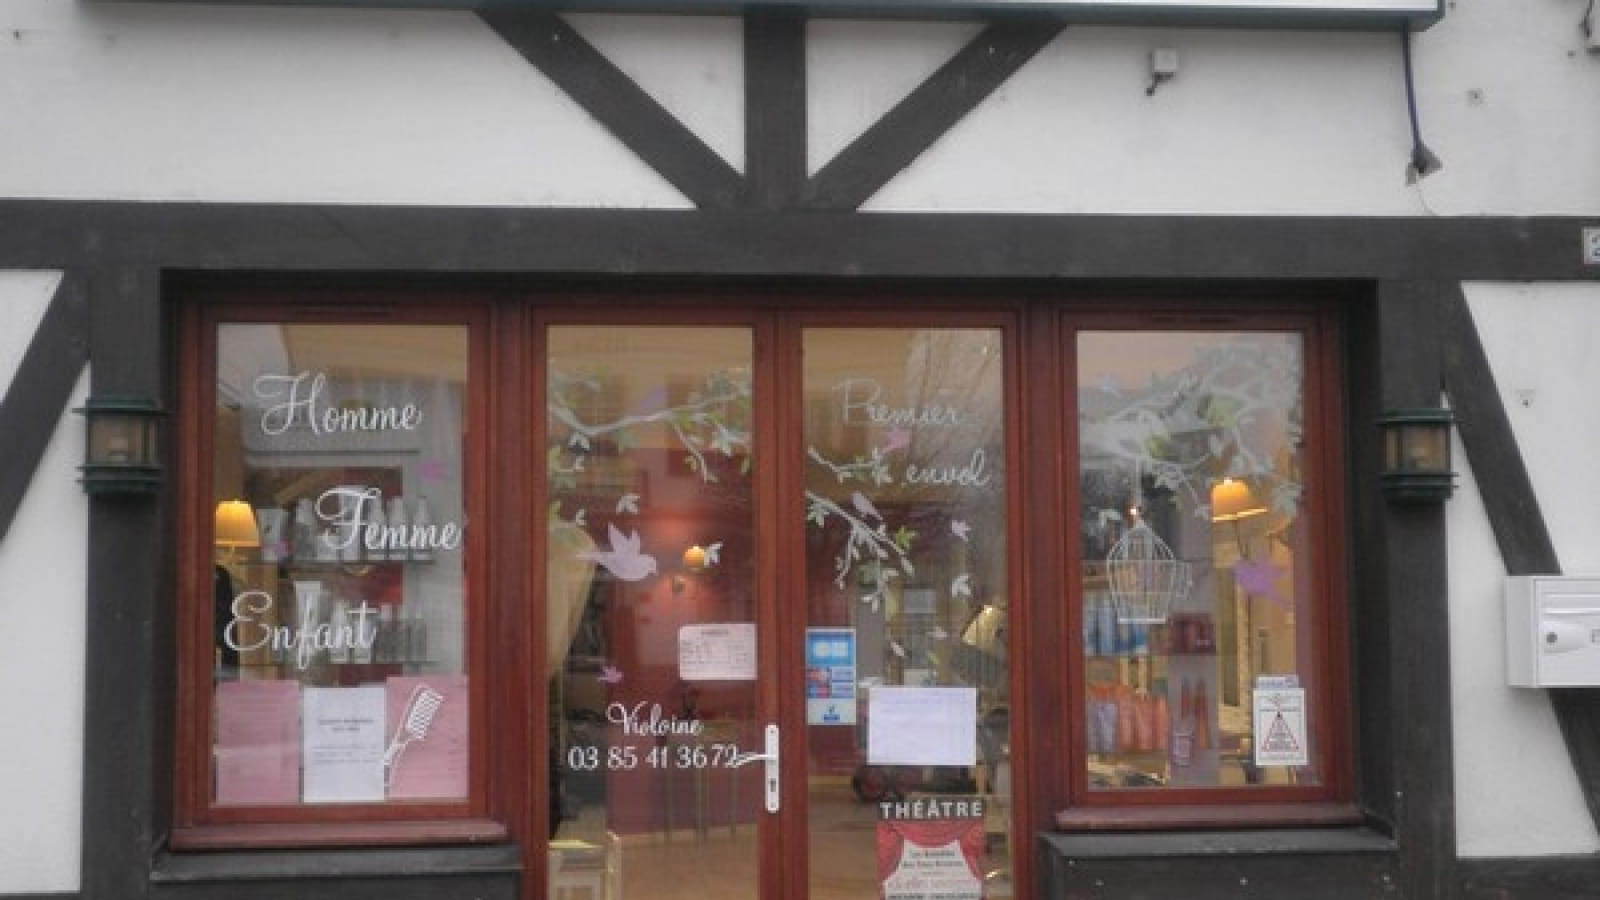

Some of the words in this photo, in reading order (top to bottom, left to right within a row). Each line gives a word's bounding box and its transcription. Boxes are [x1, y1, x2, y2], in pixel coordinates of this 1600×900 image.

[253, 369, 423, 436] Homme
[832, 374, 963, 425] Premier
[901, 447, 992, 487] envol
[313, 485, 462, 550] Femme
[222, 590, 379, 671] Enfant
[605, 700, 704, 737] Violoine
[567, 745, 600, 770] 03
[606, 746, 638, 770] 85
[644, 745, 668, 769] 41
[879, 798, 983, 820] THÉÂTRE
